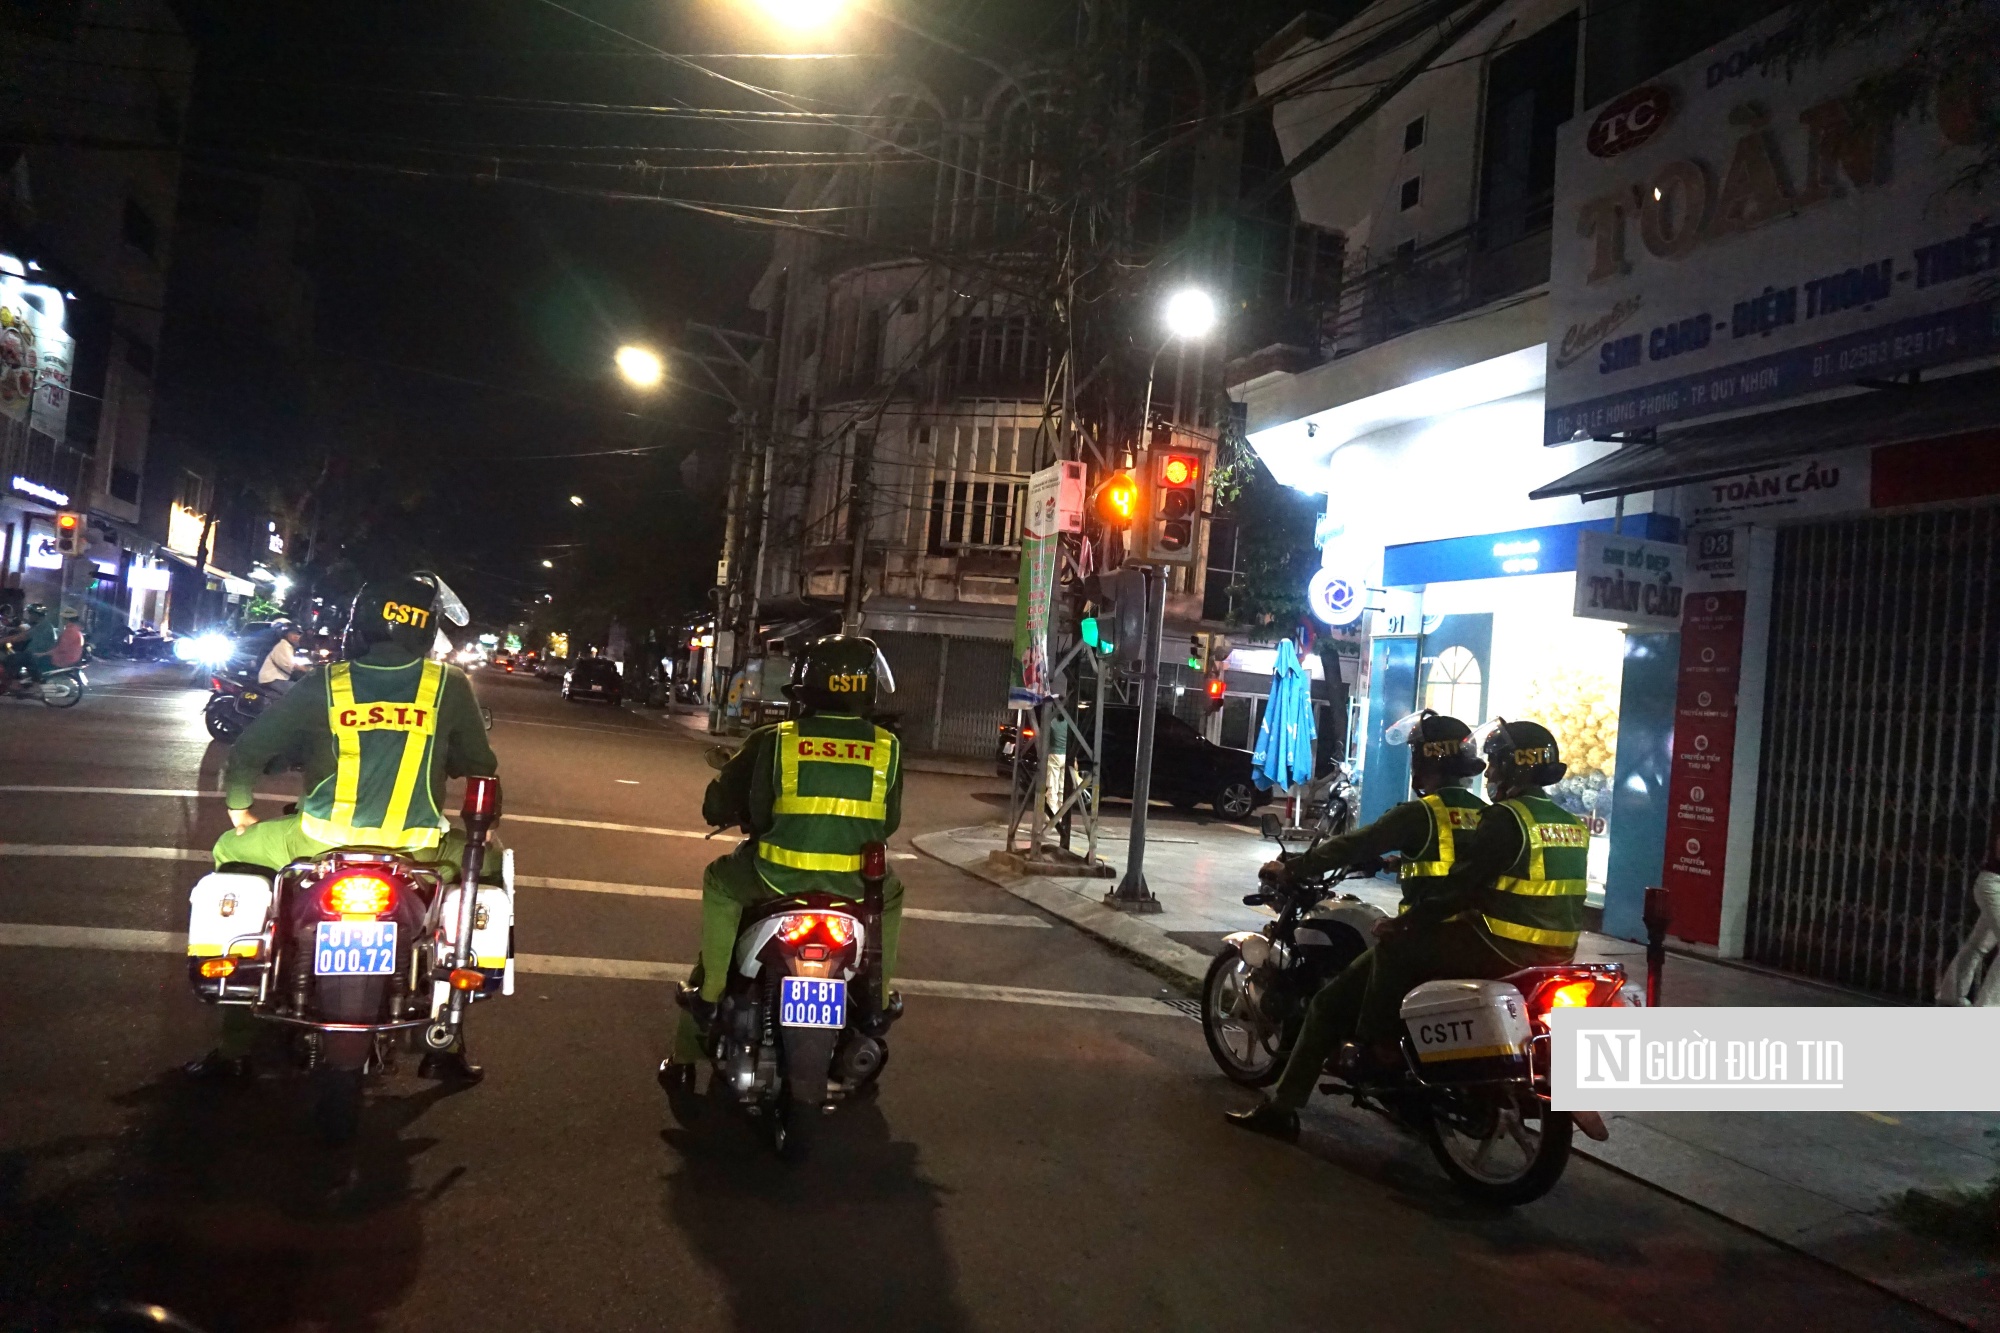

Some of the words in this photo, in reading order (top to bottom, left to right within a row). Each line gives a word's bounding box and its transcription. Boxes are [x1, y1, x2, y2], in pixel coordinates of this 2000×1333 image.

[1597, 100, 1655, 146] TC
[1599, 334, 1643, 374] SIM
[1649, 313, 1712, 361] CARD
[1712, 474, 1780, 503] TOÀN
[1785, 460, 1840, 493] CẦU
[1114, 491, 1129, 515] 4
[1703, 534, 1730, 556] 93
[1588, 569, 1641, 613] TOÀN
[382, 600, 429, 628] CSTT
[1388, 614, 1405, 634] 91
[829, 674, 868, 693] CSTT
[339, 707, 428, 728] C.S.T.T
[798, 739, 875, 760] C.S.T.T
[1423, 739, 1460, 758] CSTT
[319, 948, 392, 972] 000.72
[783, 1001, 842, 1026] 000.81
[1420, 1020, 1474, 1044] CSTT
